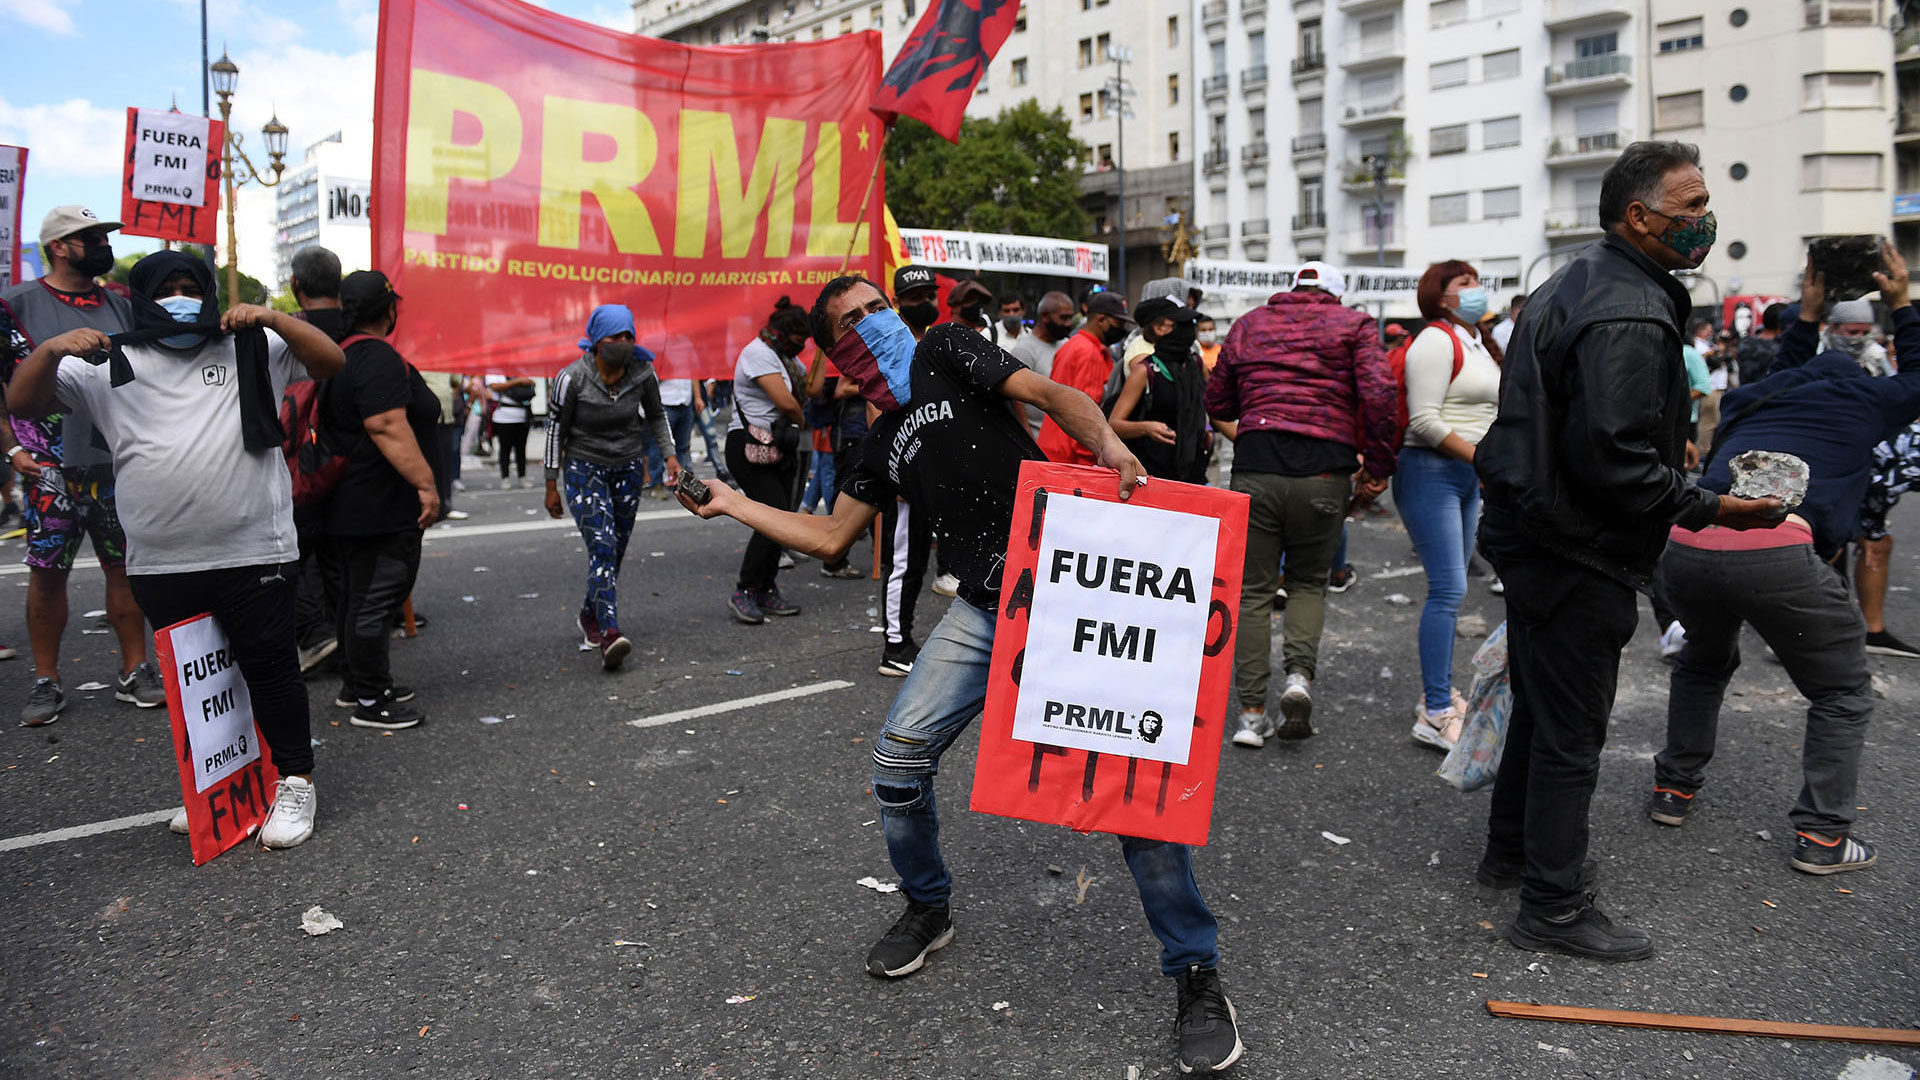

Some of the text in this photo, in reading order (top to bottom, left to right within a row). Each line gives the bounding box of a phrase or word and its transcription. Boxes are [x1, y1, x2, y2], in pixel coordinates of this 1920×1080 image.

[142, 128, 202, 149] FUERA
[153, 154, 187, 170] FMI
[404, 68, 870, 260] PRML
[144, 183, 181, 197] PRML
[921, 235, 947, 262] PTS
[403, 248, 500, 274] PARTIDO
[507, 259, 695, 286] REVOLUCIONARIO
[700, 271, 793, 286] MARXISTA
[888, 400, 954, 485] BALENCIAGA
[903, 437, 922, 465] PARIS
[1049, 548, 1197, 604] FUERA
[1072, 617, 1158, 664] FMI
[201, 688, 236, 723] FMI
[1043, 700, 1133, 735] PRML
[205, 743, 239, 774] PRML
[207, 764, 270, 841] FMI
